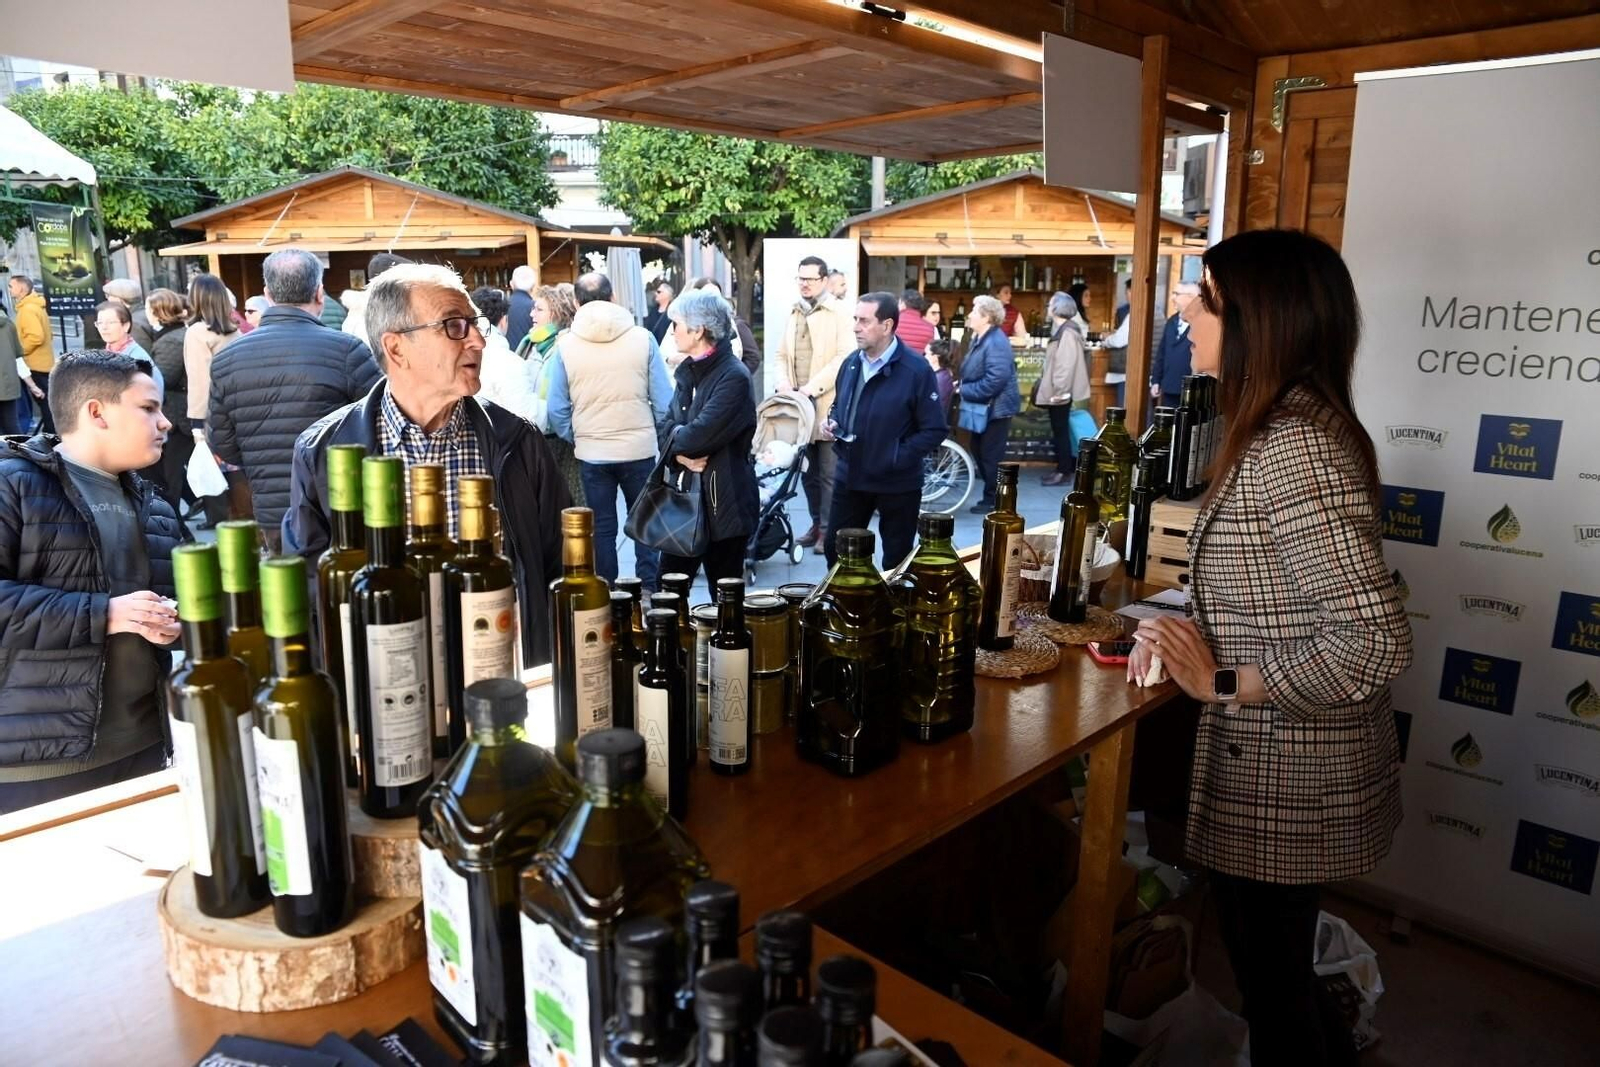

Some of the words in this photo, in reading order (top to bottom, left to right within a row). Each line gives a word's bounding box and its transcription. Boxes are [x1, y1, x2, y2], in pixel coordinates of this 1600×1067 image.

[1390, 427, 1443, 445] LUCENTINA
[1497, 442, 1536, 458] Vital
[1489, 455, 1538, 473] Heart
[1388, 509, 1423, 526] Vital
[1382, 521, 1423, 539] Heart
[1464, 597, 1520, 617] LUCENTINA
[1461, 673, 1496, 692] Vital
